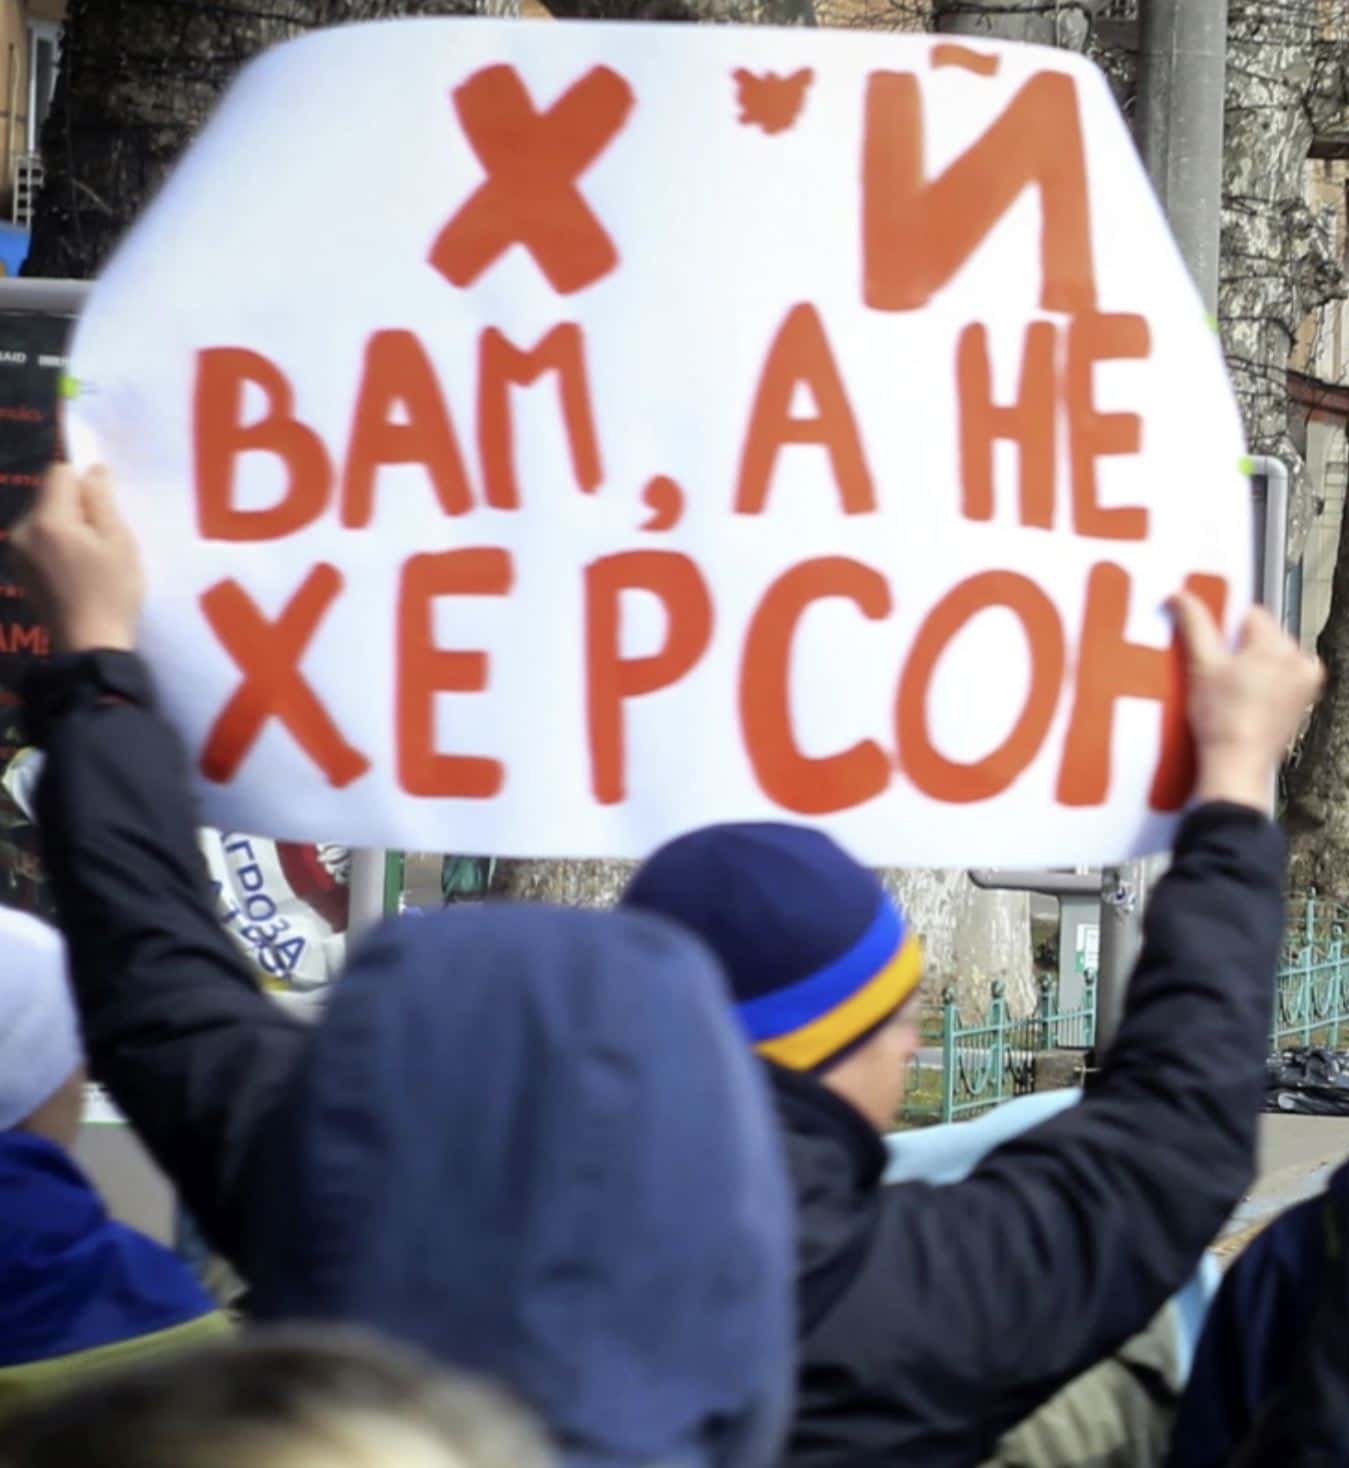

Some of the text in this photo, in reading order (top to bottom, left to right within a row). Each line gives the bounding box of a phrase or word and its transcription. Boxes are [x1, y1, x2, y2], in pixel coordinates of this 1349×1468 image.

[735, 303, 875, 515] А
[956, 312, 1151, 541] НЕ
[200, 547, 1229, 816] ХЕРСОН
[222, 832, 306, 972] ГРОЗА
